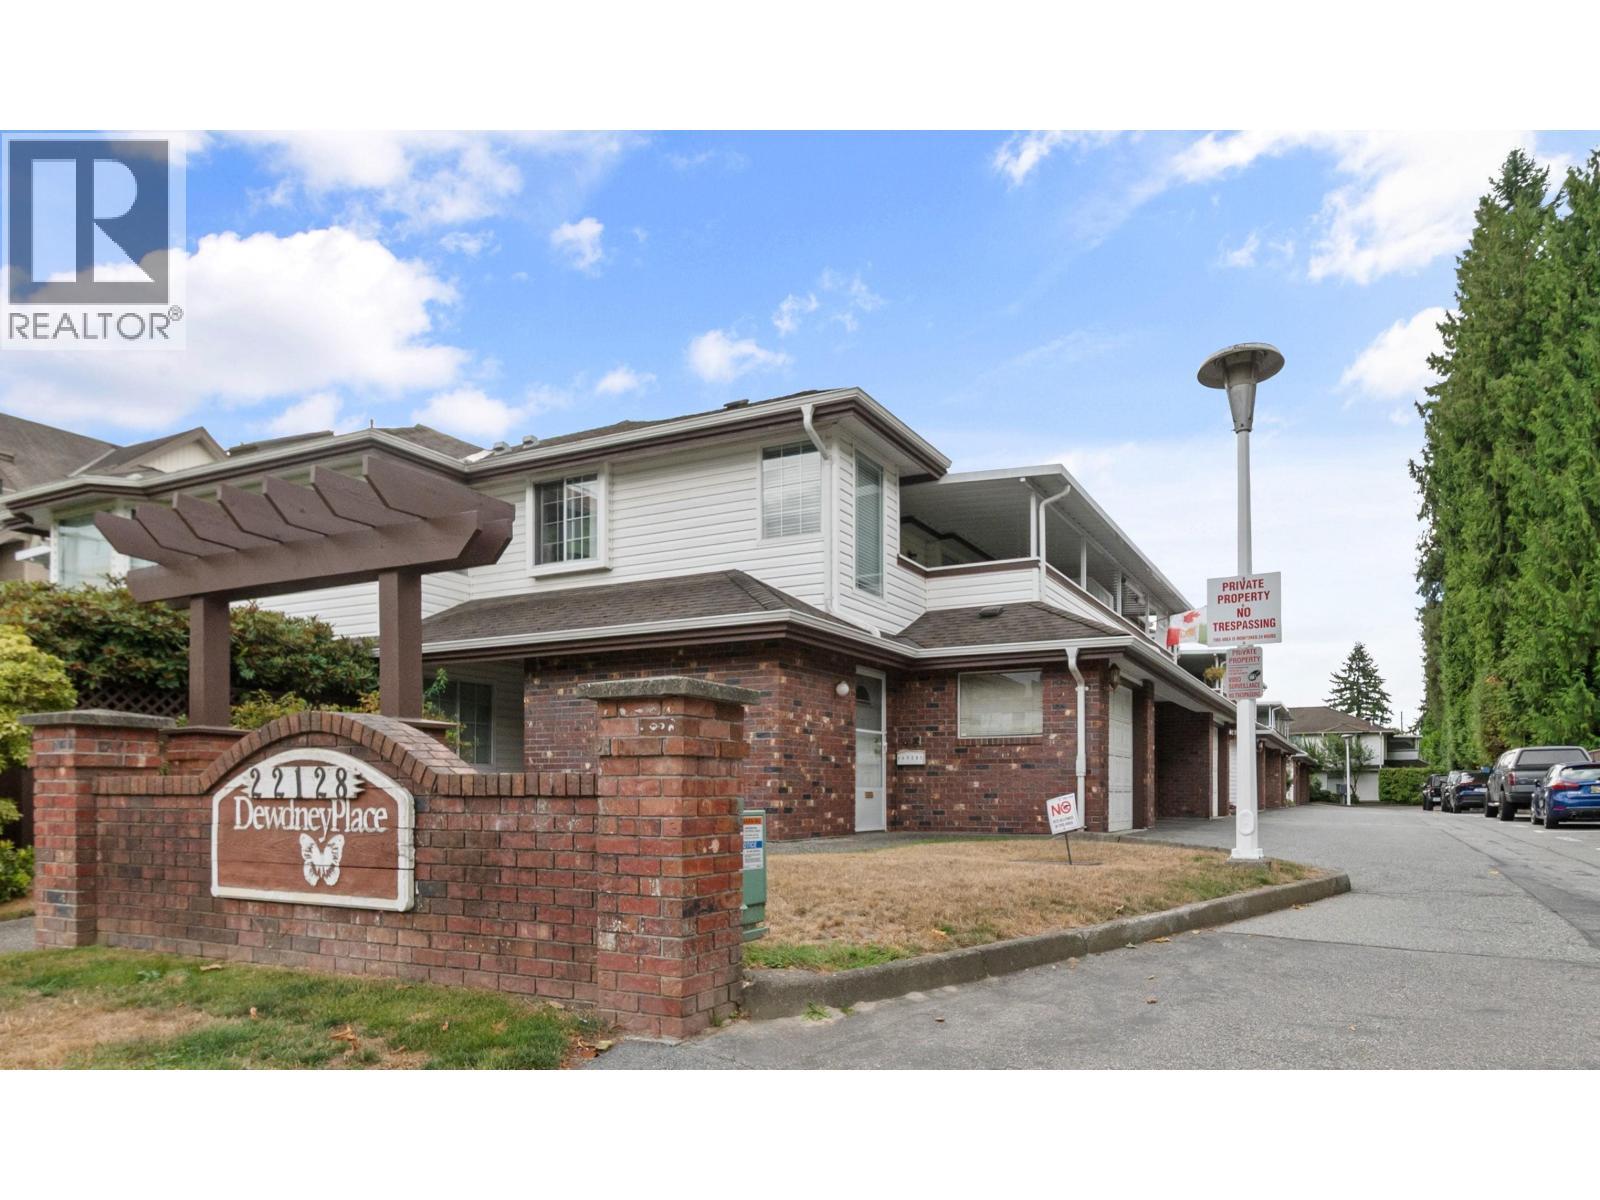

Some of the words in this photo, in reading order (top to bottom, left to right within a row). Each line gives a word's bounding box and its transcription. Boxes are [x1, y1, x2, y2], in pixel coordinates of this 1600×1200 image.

[1222, 578, 1264, 592] PRIVATE
[1217, 590, 1271, 605] PROPERTY
[1236, 607, 1251, 618] NO
[1213, 618, 1276, 632] TRESPASSING
[1232, 648, 1257, 656] PRIVATE
[1228, 656, 1261, 664] PROPERTY
[249, 766, 348, 800] 22128
